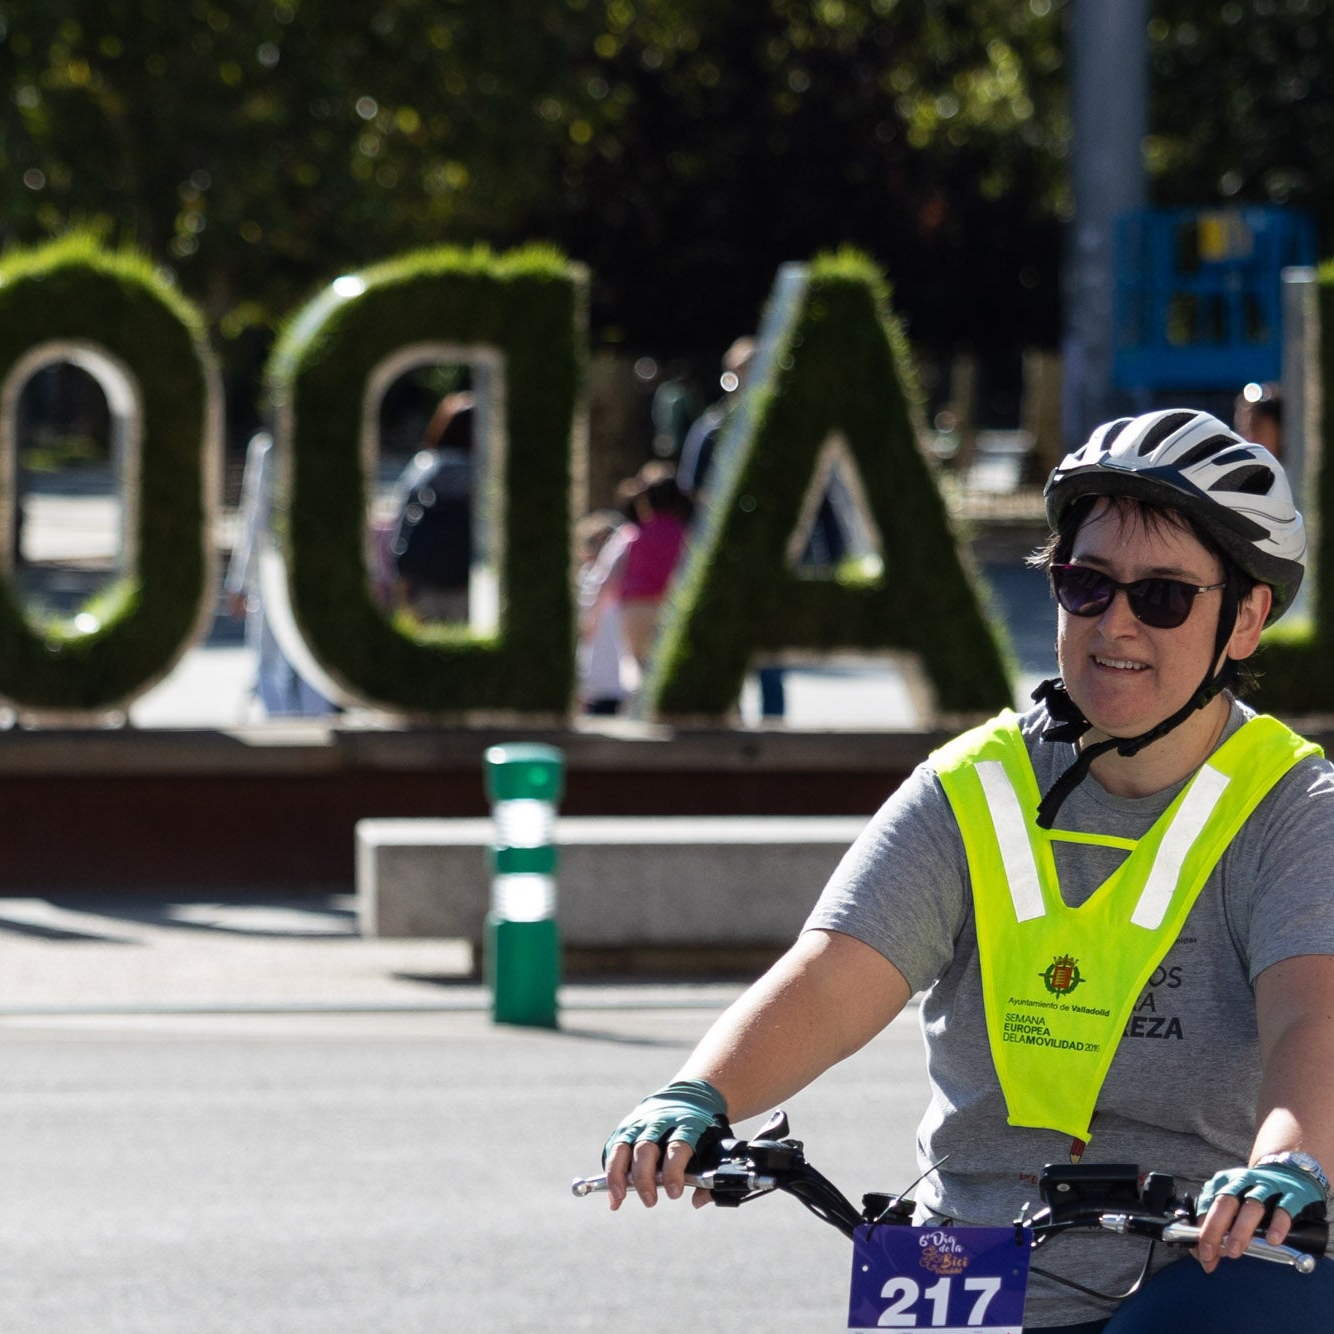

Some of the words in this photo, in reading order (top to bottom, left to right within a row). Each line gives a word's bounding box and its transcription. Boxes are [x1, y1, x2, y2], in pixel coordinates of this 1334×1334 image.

[1007, 996, 1058, 1010] Ayuntamiento
[1060, 1003, 1070, 1011] de
[1071, 1005, 1110, 1017] Valladolid
[1005, 1013, 1046, 1026] SEMANA
[1124, 1016, 1184, 1039] EZA
[1004, 1023, 1051, 1036] EUROPEA
[938, 1244, 950, 1253] de
[877, 1277, 1001, 1326] 217
